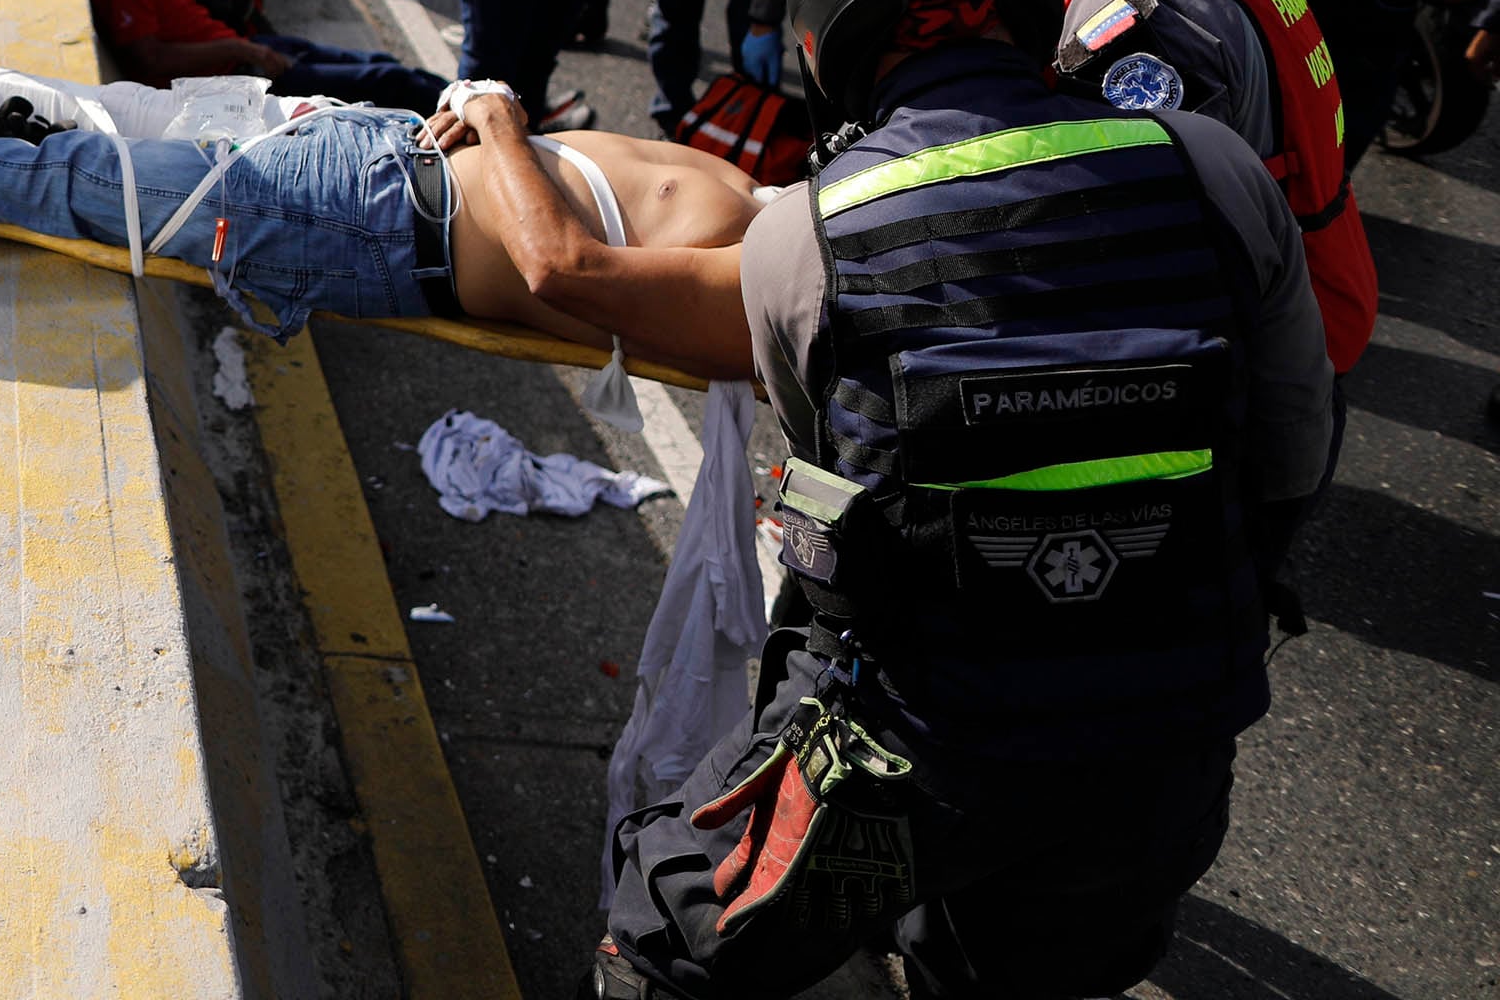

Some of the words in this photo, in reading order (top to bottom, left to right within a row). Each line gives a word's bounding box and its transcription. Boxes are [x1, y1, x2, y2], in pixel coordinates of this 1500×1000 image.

[973, 379, 1177, 415] PARAMÉDICOS
[1061, 513, 1087, 529] DE
[1091, 510, 1126, 526] LAS
